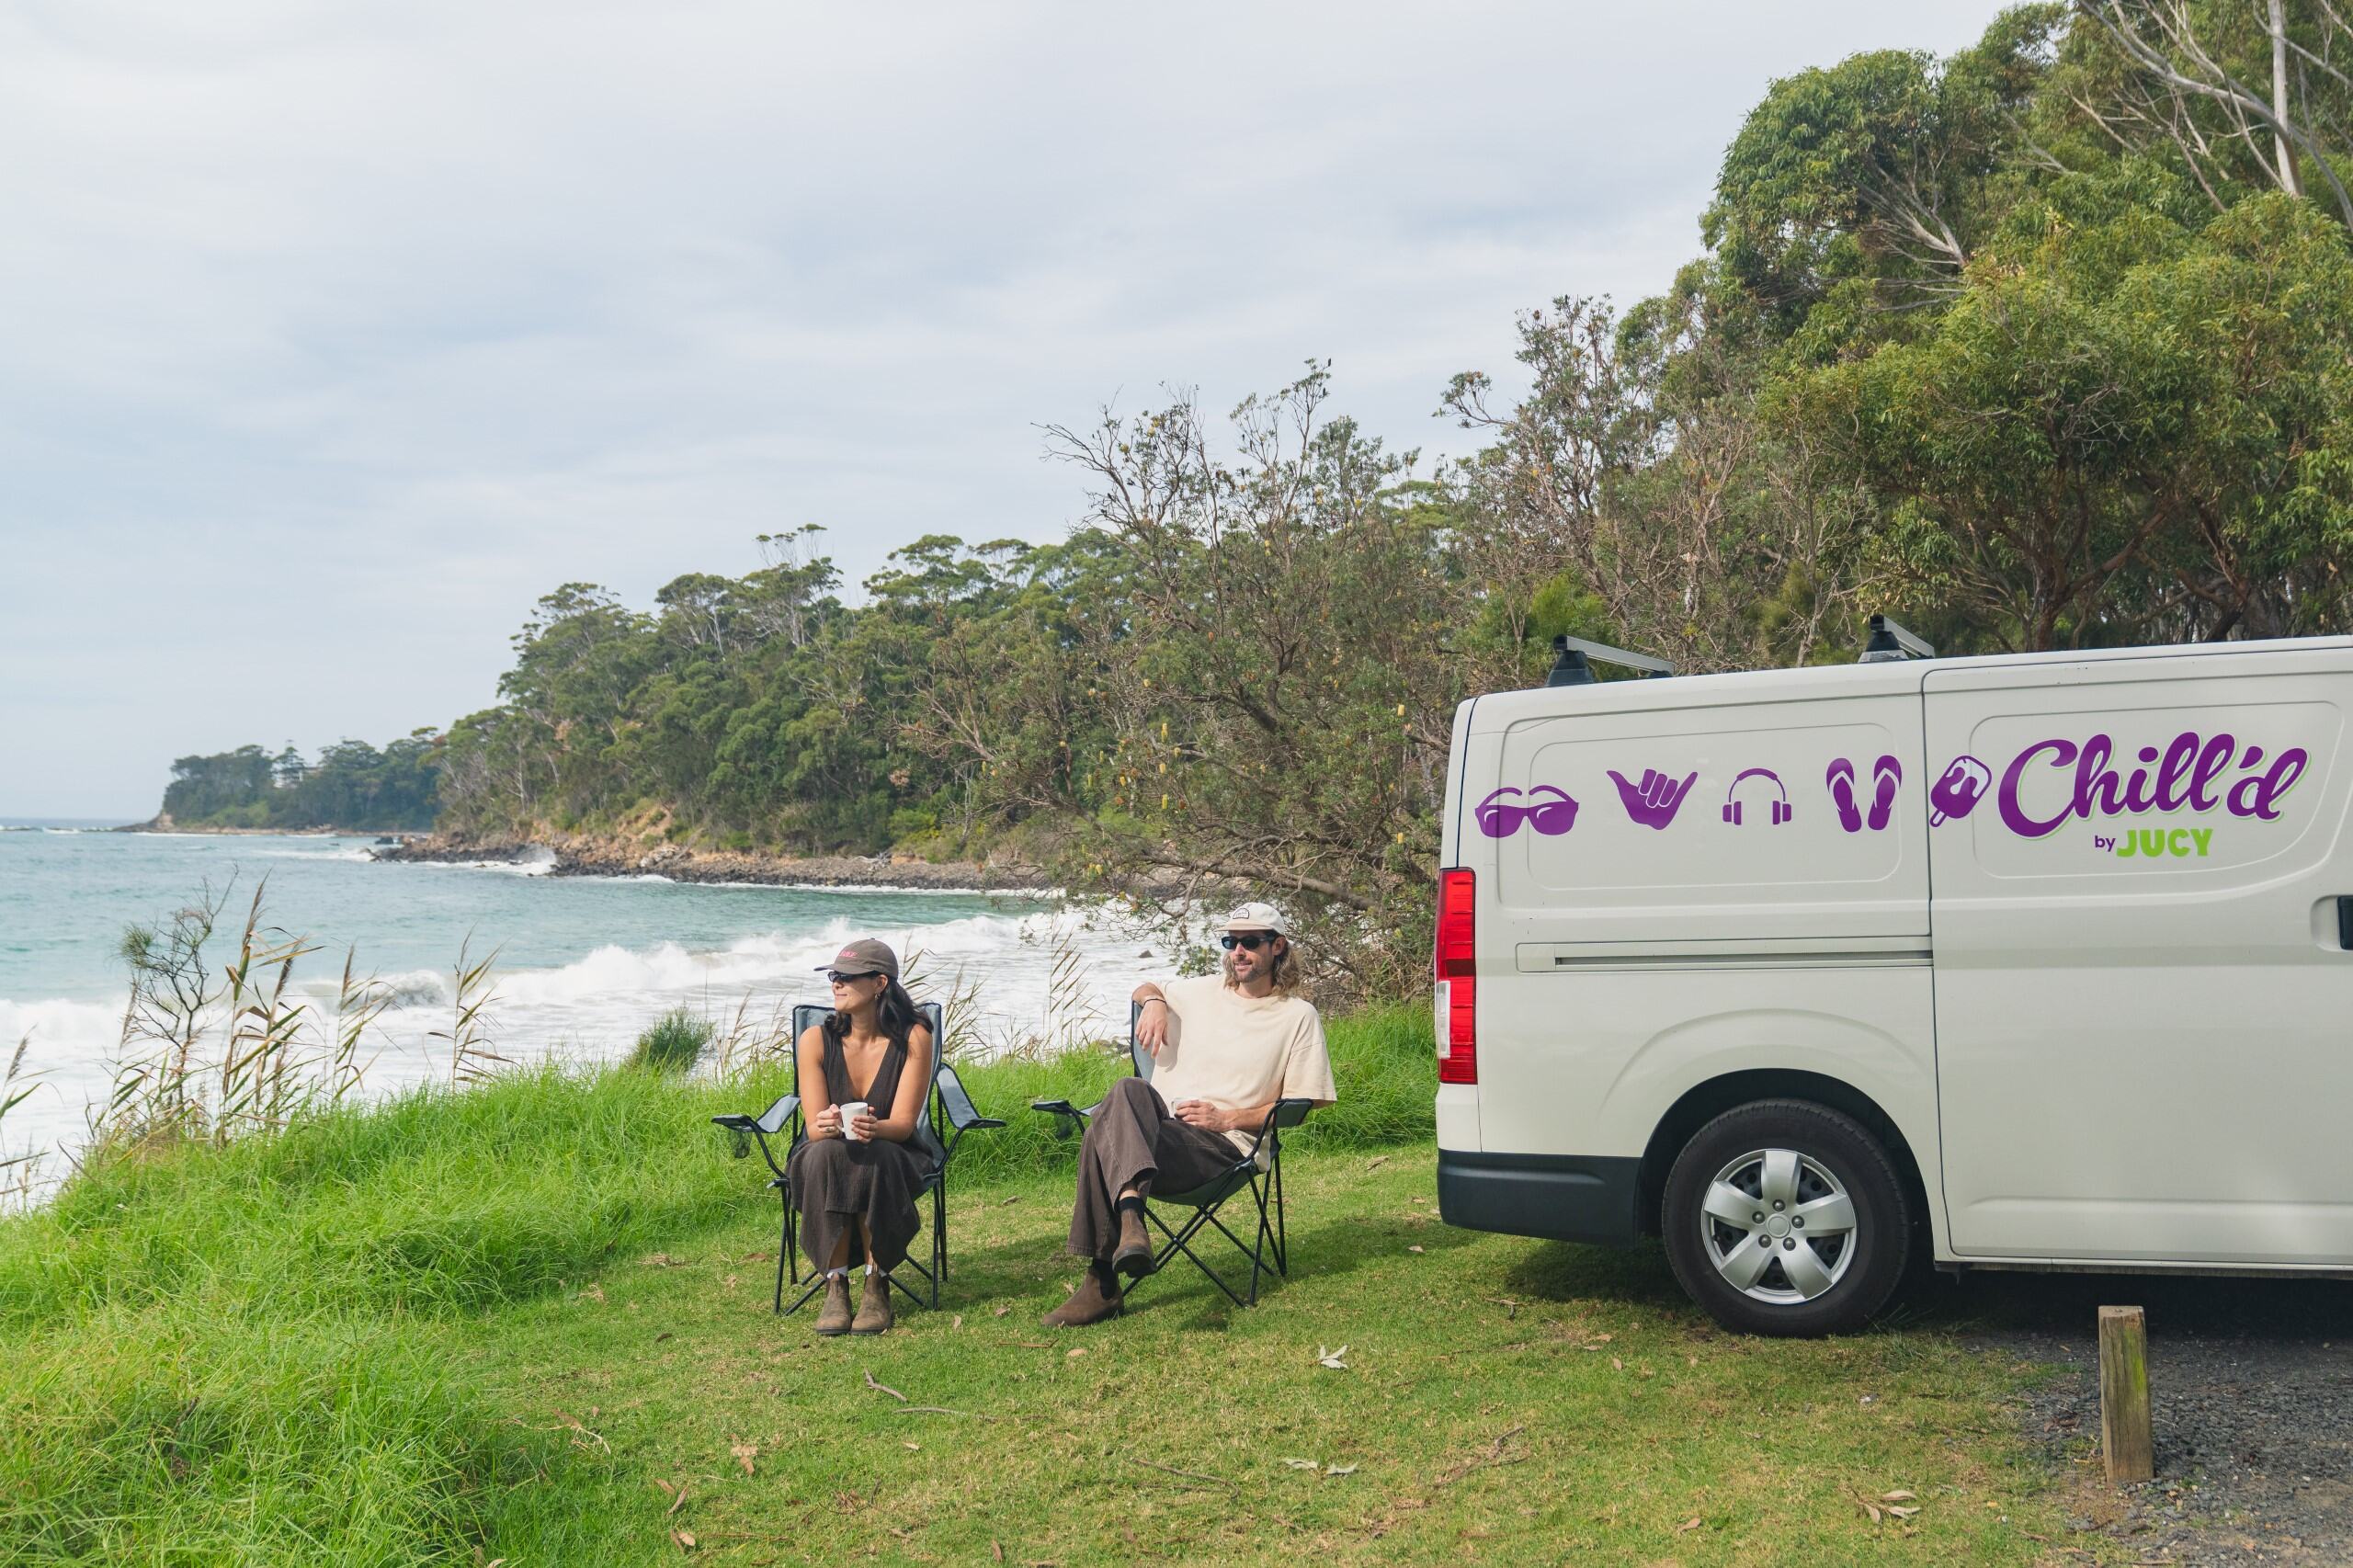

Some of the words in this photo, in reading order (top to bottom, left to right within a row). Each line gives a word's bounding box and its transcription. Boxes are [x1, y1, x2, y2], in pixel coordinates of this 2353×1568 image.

[1998, 732, 2308, 838] Chill'd
[2094, 835, 2116, 853] by
[2116, 828, 2213, 858] JUCY
